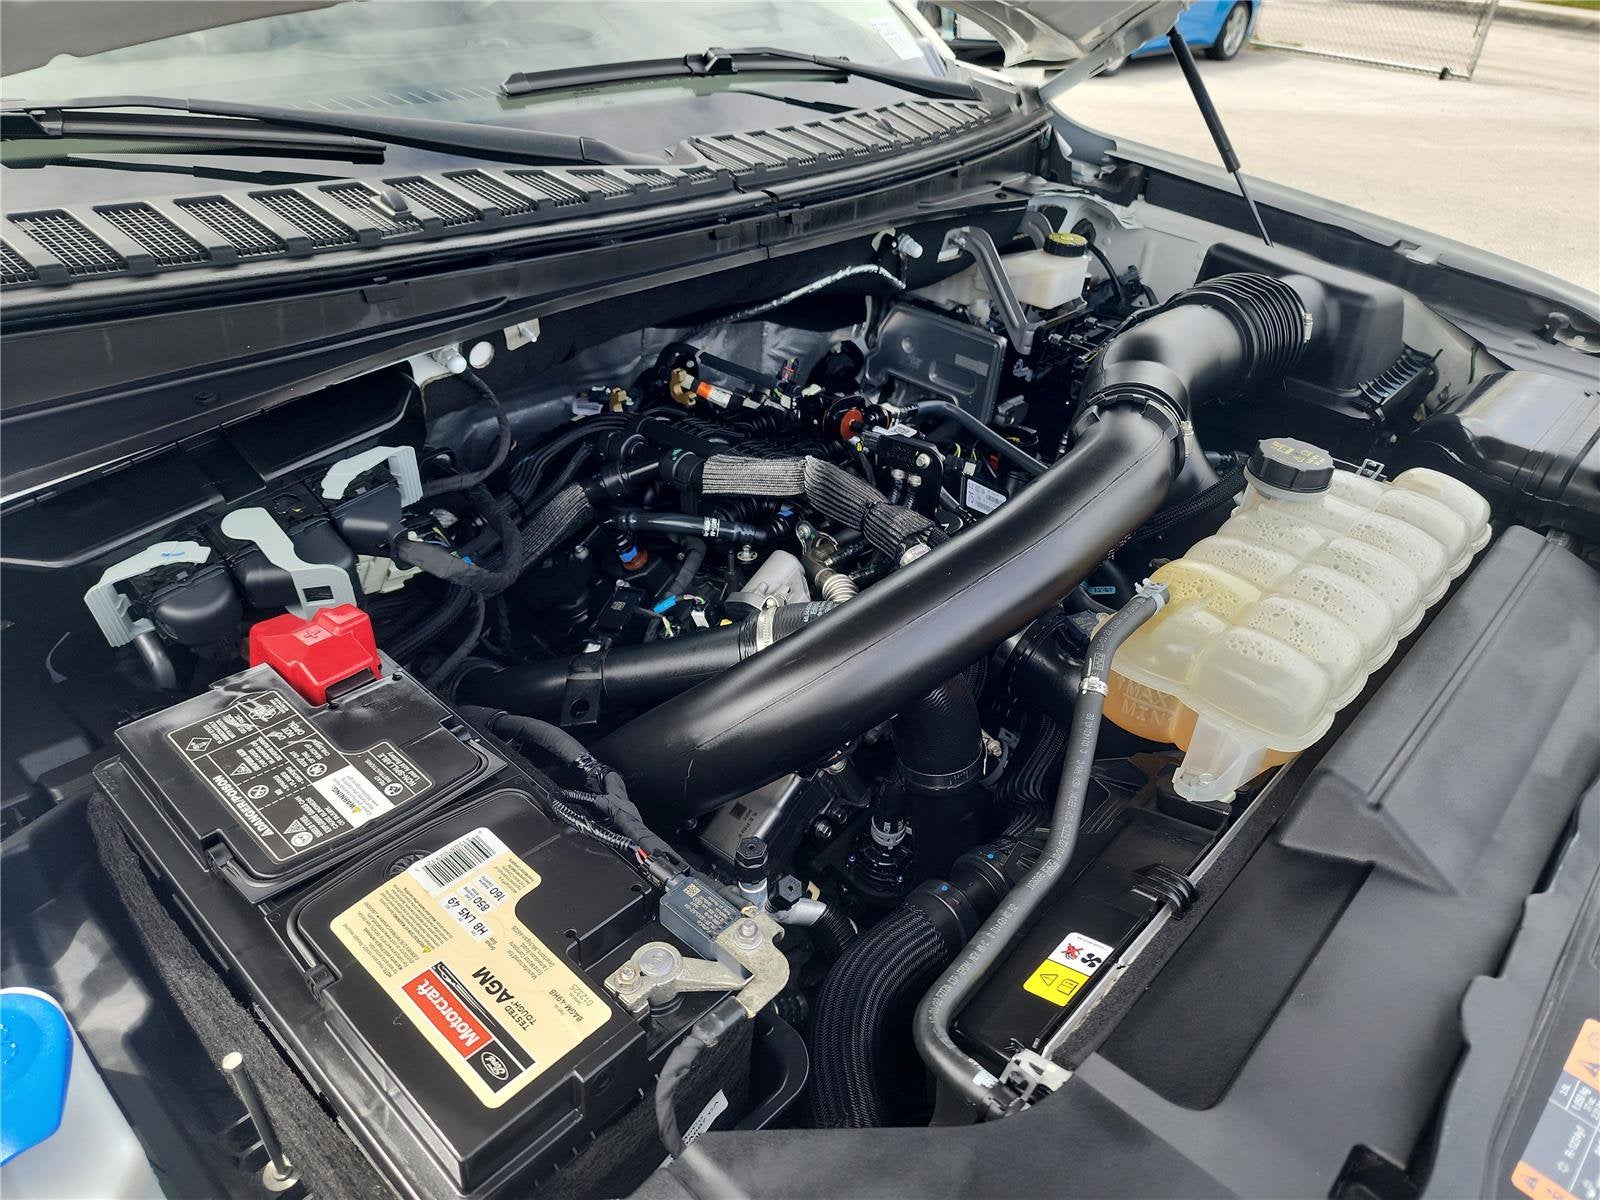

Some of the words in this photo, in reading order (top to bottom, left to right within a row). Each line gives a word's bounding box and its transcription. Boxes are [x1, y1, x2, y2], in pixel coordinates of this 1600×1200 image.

[1126, 682, 1169, 709] MAX
[1122, 697, 1161, 729] MIN
[273, 730, 286, 740] DO
[280, 726, 296, 737] NOT
[247, 748, 261, 760] CAUSE
[288, 750, 300, 758] OUT
[300, 750, 311, 758] THE
[308, 747, 323, 760] REACH
[387, 750, 403, 763] Battery
[257, 758, 269, 767] CAN
[296, 757, 308, 767] KEEP
[377, 751, 416, 786] NON-SPILLABLE
[398, 761, 411, 771] Acid
[372, 775, 387, 786] READ
[407, 770, 420, 780] Lead
[212, 773, 268, 831] DANGER/POISON
[293, 795, 306, 805] CAN
[329, 785, 357, 809] WARNING:
[300, 802, 316, 815] GASES
[304, 796, 328, 817] BLINDNESS
[310, 813, 332, 833] EXPLOSIVE
[322, 815, 339, 829] CAUSE
[336, 818, 346, 826] OR
[488, 886, 505, 901] 160
[446, 895, 461, 909] 49
[472, 895, 490, 912] 850
[457, 906, 476, 924] LN5
[507, 940, 526, 958] Company
[520, 934, 538, 951] Michigan
[506, 948, 514, 956] for
[511, 954, 537, 980] Manufactured
[522, 955, 535, 968] Motor
[528, 951, 547, 969] American
[532, 965, 543, 976] Ford
[471, 964, 514, 1007] AGM
[413, 977, 480, 1047] Motorcraft
[503, 1004, 530, 1030] TESTED
[482, 1053, 507, 1077] Ford
